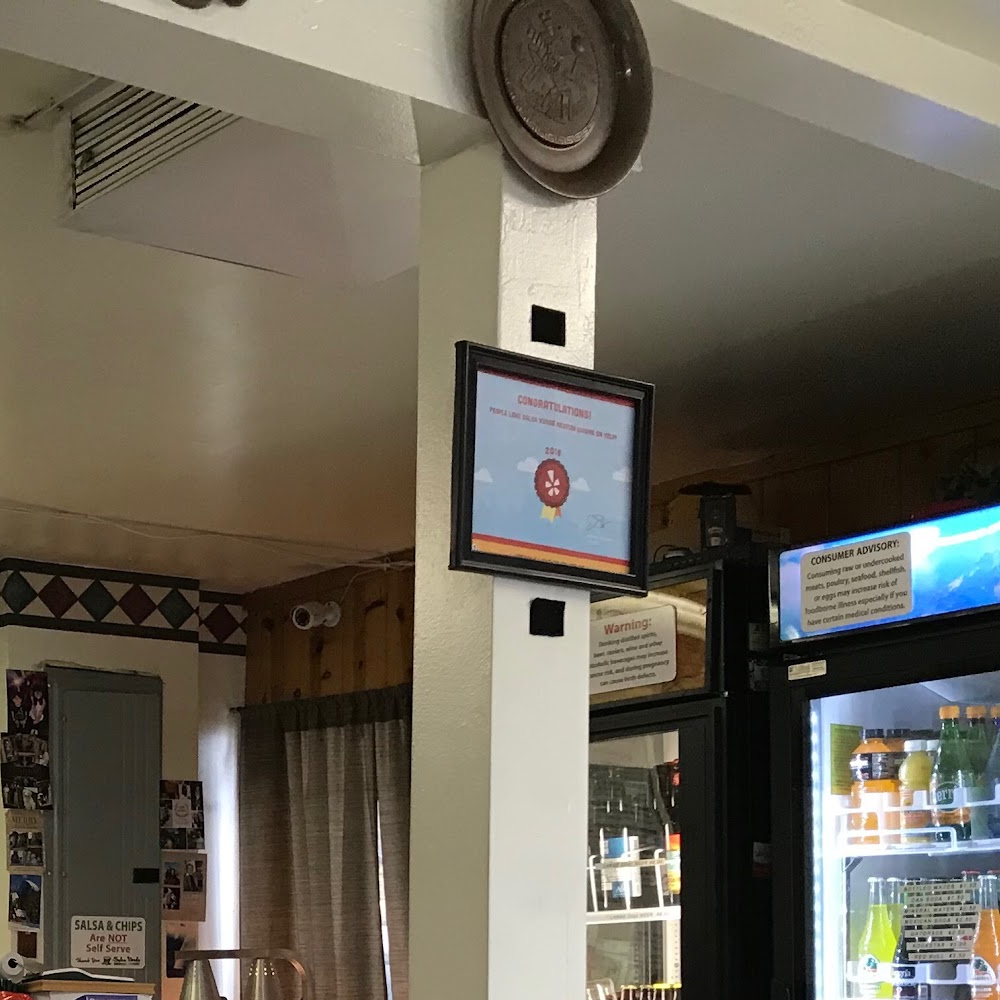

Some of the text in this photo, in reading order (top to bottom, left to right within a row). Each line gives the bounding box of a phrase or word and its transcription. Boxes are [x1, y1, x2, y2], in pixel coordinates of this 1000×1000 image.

[811, 539, 900, 565] CONSUMER ADVISORY:
[604, 619, 652, 634] Warning:
[75, 920, 142, 931] SALSA & CHIPS
[90, 934, 127, 942] Are NOT
[86, 944, 130, 953] Self Serve
